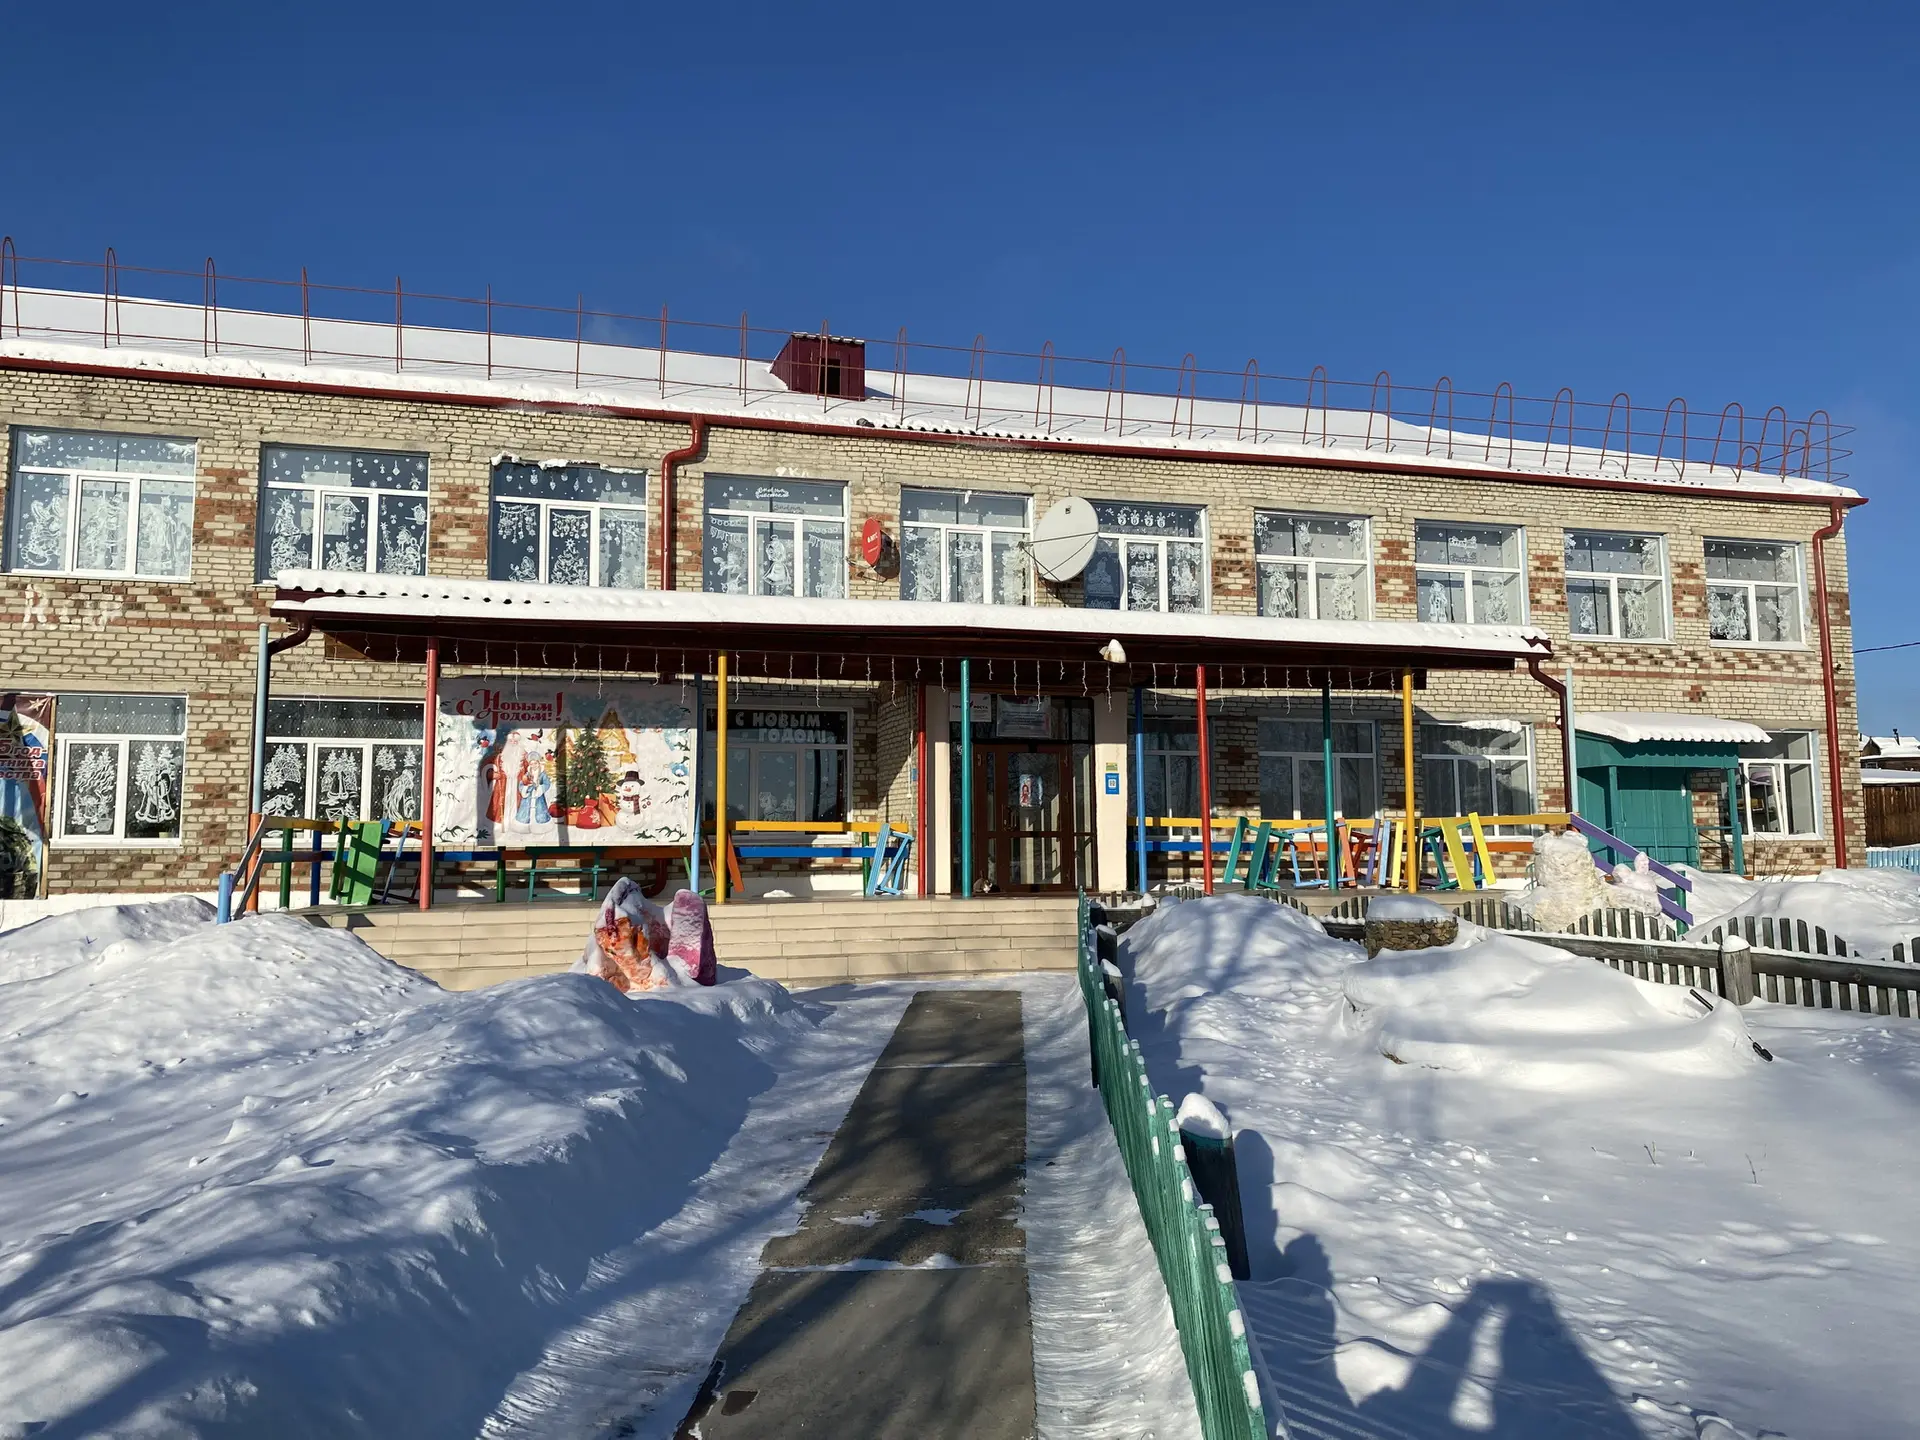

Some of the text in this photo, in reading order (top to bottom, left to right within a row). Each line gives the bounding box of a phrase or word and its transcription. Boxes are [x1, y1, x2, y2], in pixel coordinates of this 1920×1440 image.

[735, 711, 821, 729] С НОВЫМ
[758, 728, 827, 744] ГОДОМ!
[13, 746, 47, 758] год-
